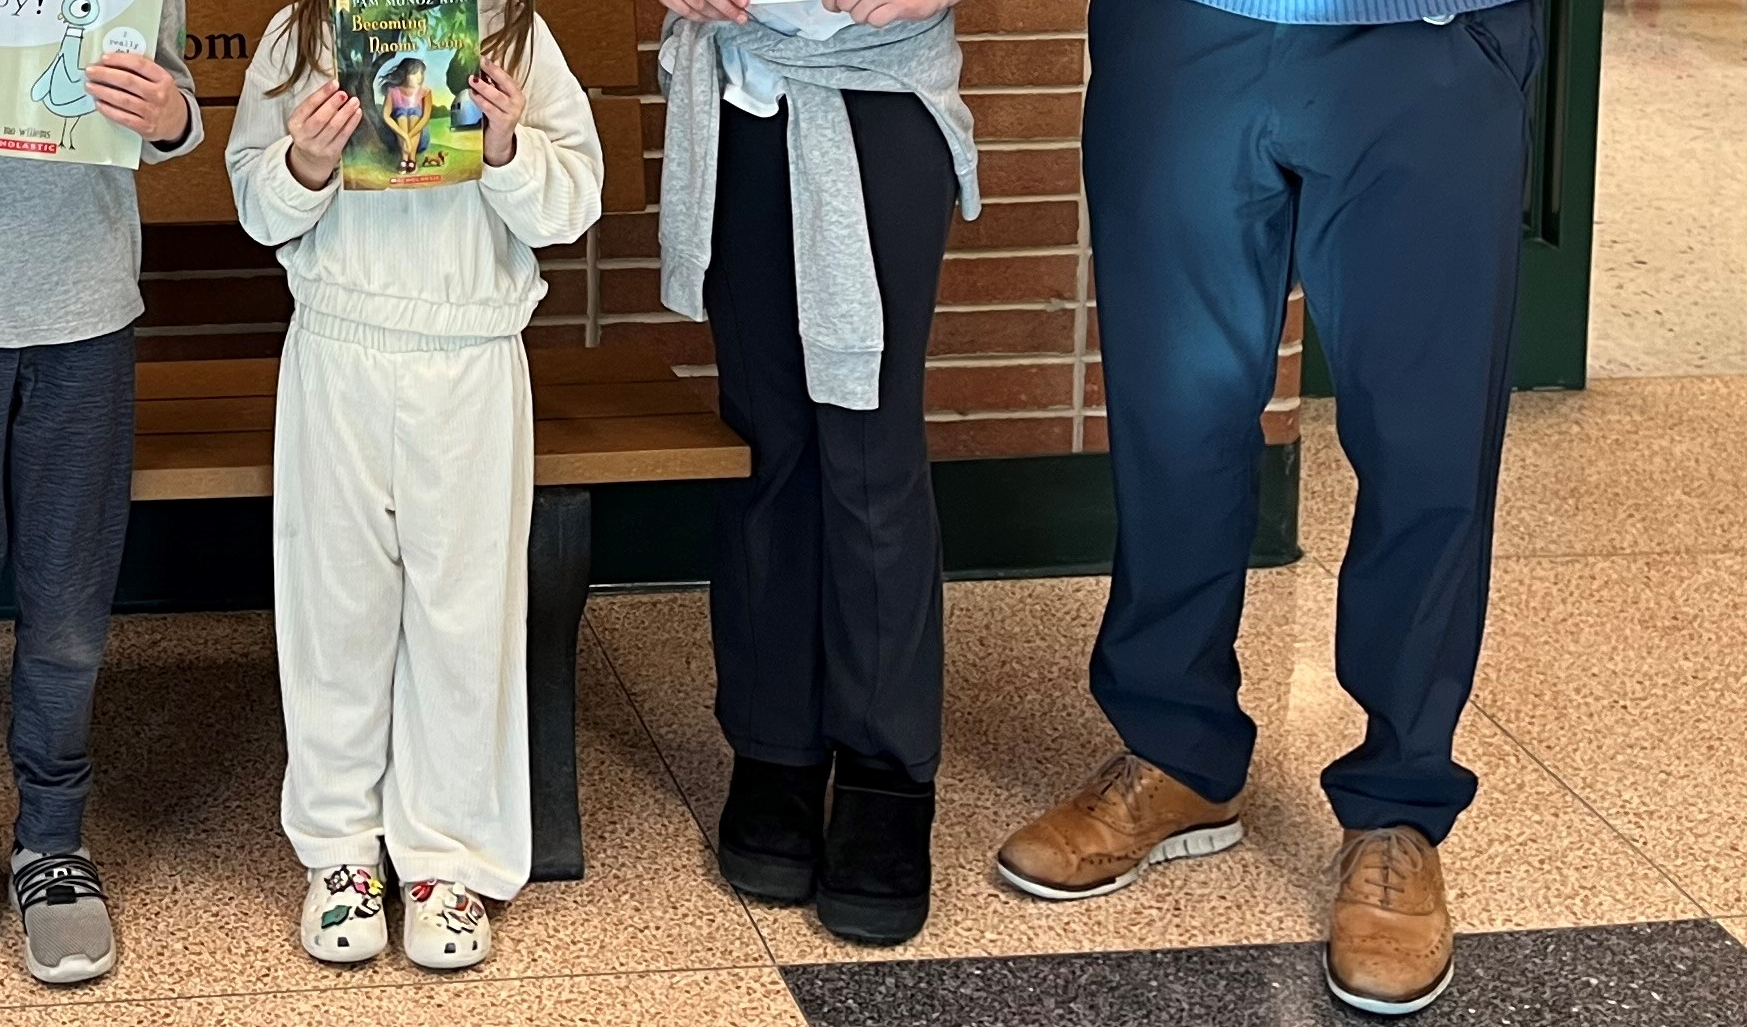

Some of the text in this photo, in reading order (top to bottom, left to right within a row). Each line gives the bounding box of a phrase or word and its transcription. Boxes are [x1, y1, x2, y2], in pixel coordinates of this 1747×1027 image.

[352, 13, 427, 36] Becoming
[110, 40, 138, 50] really
[369, 36, 416, 54] Naomi
